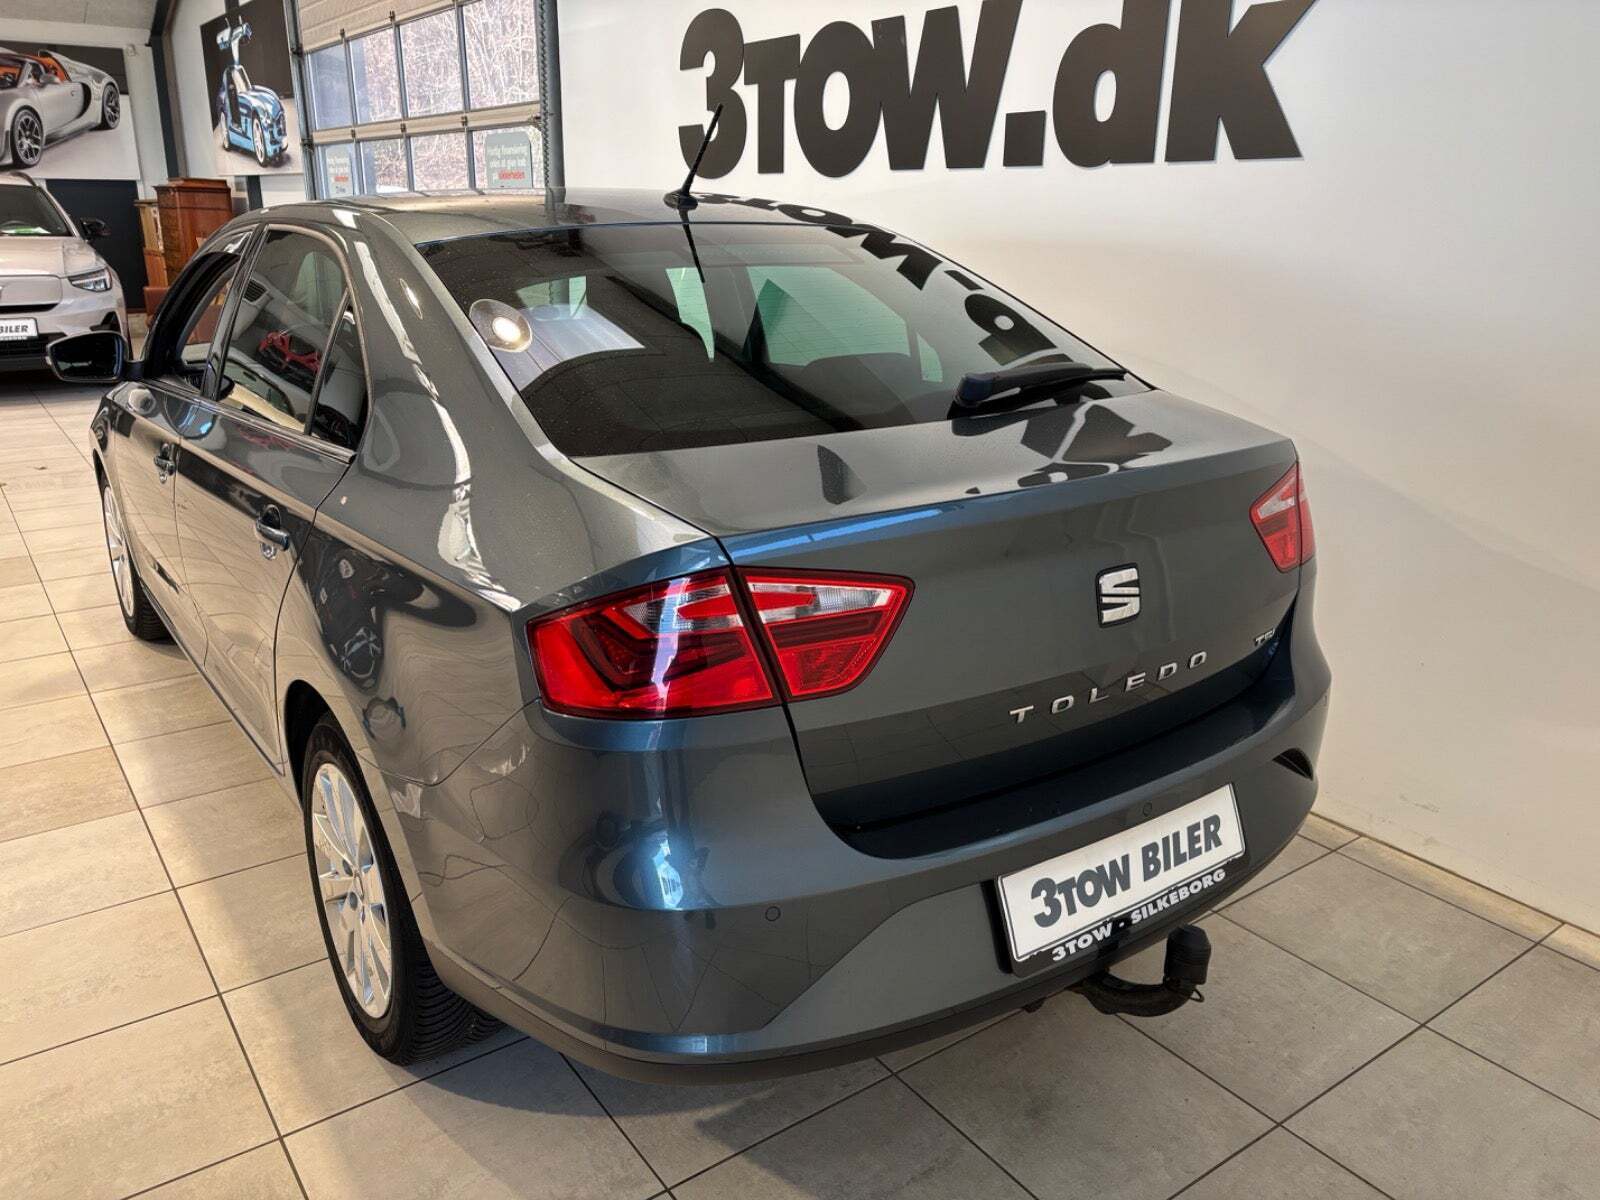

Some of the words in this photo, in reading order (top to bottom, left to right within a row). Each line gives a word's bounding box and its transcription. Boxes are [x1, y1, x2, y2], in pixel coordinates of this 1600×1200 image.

[1008, 651, 1208, 723] TOLEDO
[1031, 853, 1131, 928] 3TOW
[1141, 814, 1222, 882] BILER
[1052, 922, 1113, 962] 3TOW
[1130, 868, 1227, 924] SILKEBORG
